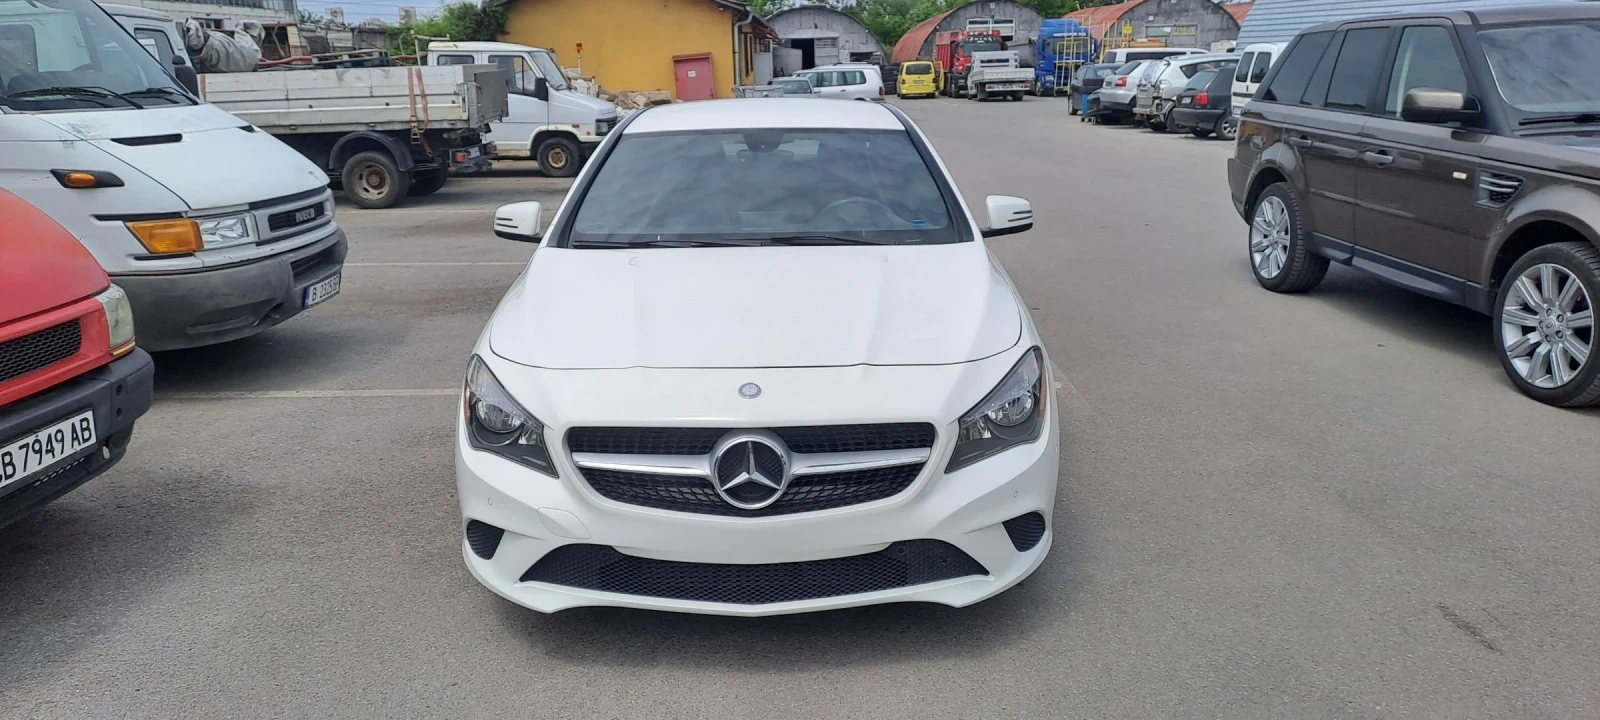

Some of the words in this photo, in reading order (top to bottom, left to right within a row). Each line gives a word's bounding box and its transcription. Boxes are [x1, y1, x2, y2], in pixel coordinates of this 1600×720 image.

[296, 208, 315, 222] IVECO
[312, 287, 317, 302] B
[0, 451, 16, 482] B
[18, 428, 65, 473] 7949
[70, 416, 92, 449] AB
